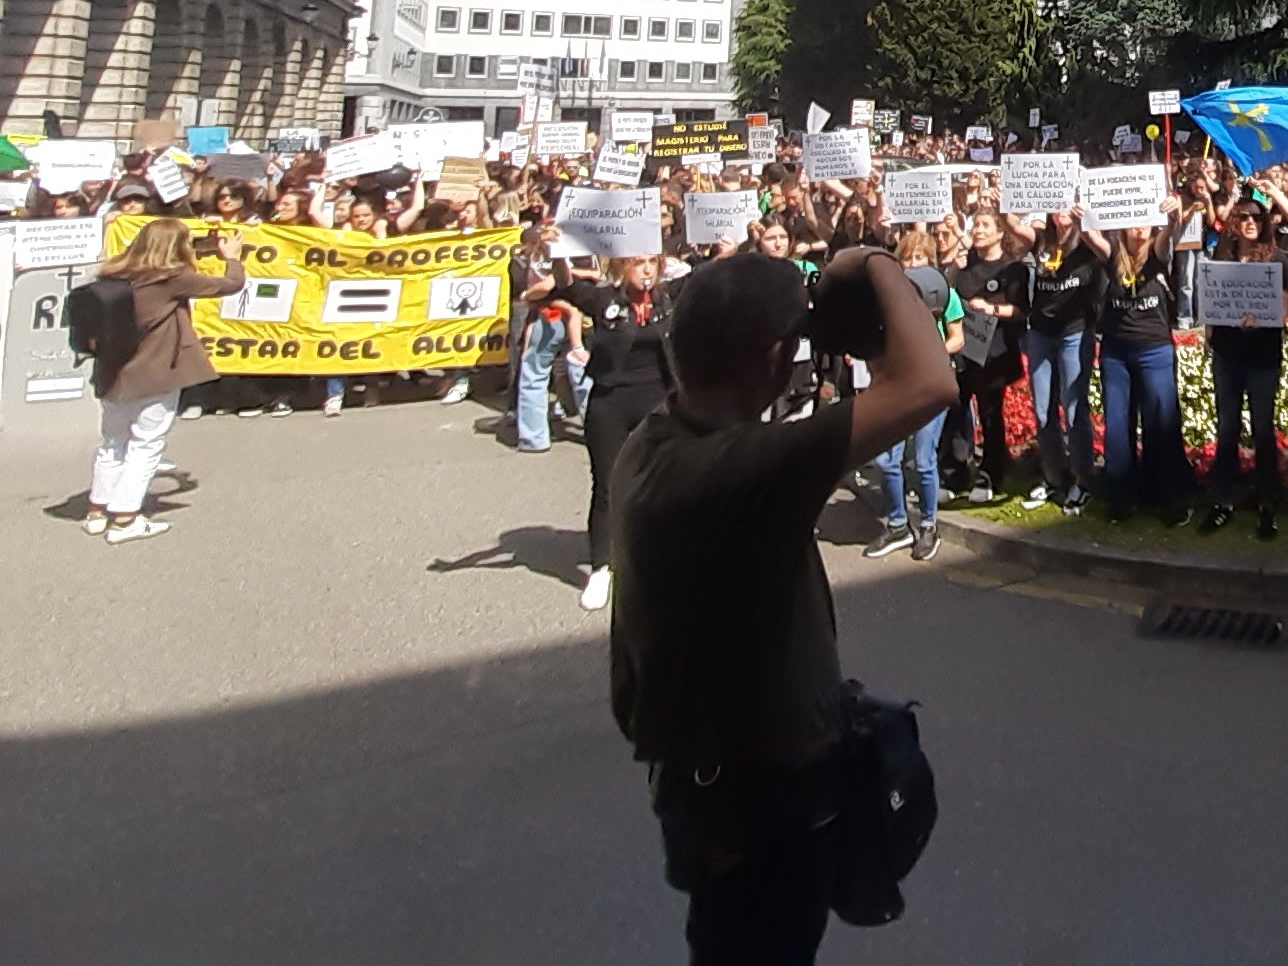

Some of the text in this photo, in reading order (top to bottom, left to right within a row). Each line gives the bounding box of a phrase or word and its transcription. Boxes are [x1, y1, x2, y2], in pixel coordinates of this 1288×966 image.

[1023, 161, 1054, 169] POR LA
[1011, 170, 1066, 179] LUCHA PARA
[1004, 181, 1022, 189] UNA
[1097, 177, 1105, 185] LA
[1013, 191, 1064, 199] DE CALIDAD
[1102, 188, 1123, 197] PUEDE
[1009, 201, 1032, 209] PARA
[892, 208, 913, 216] CASO
[705, 219, 735, 227] SALARIAL
[583, 225, 627, 235] SALARIAL
[304, 247, 347, 268] AL
[1231, 290, 1243, 298] EN
[1245, 291, 1277, 299] LUCHA
[1213, 301, 1269, 310] POR EL BIEN
[1226, 312, 1277, 321] ALUADO
[317, 339, 381, 360] DEL
